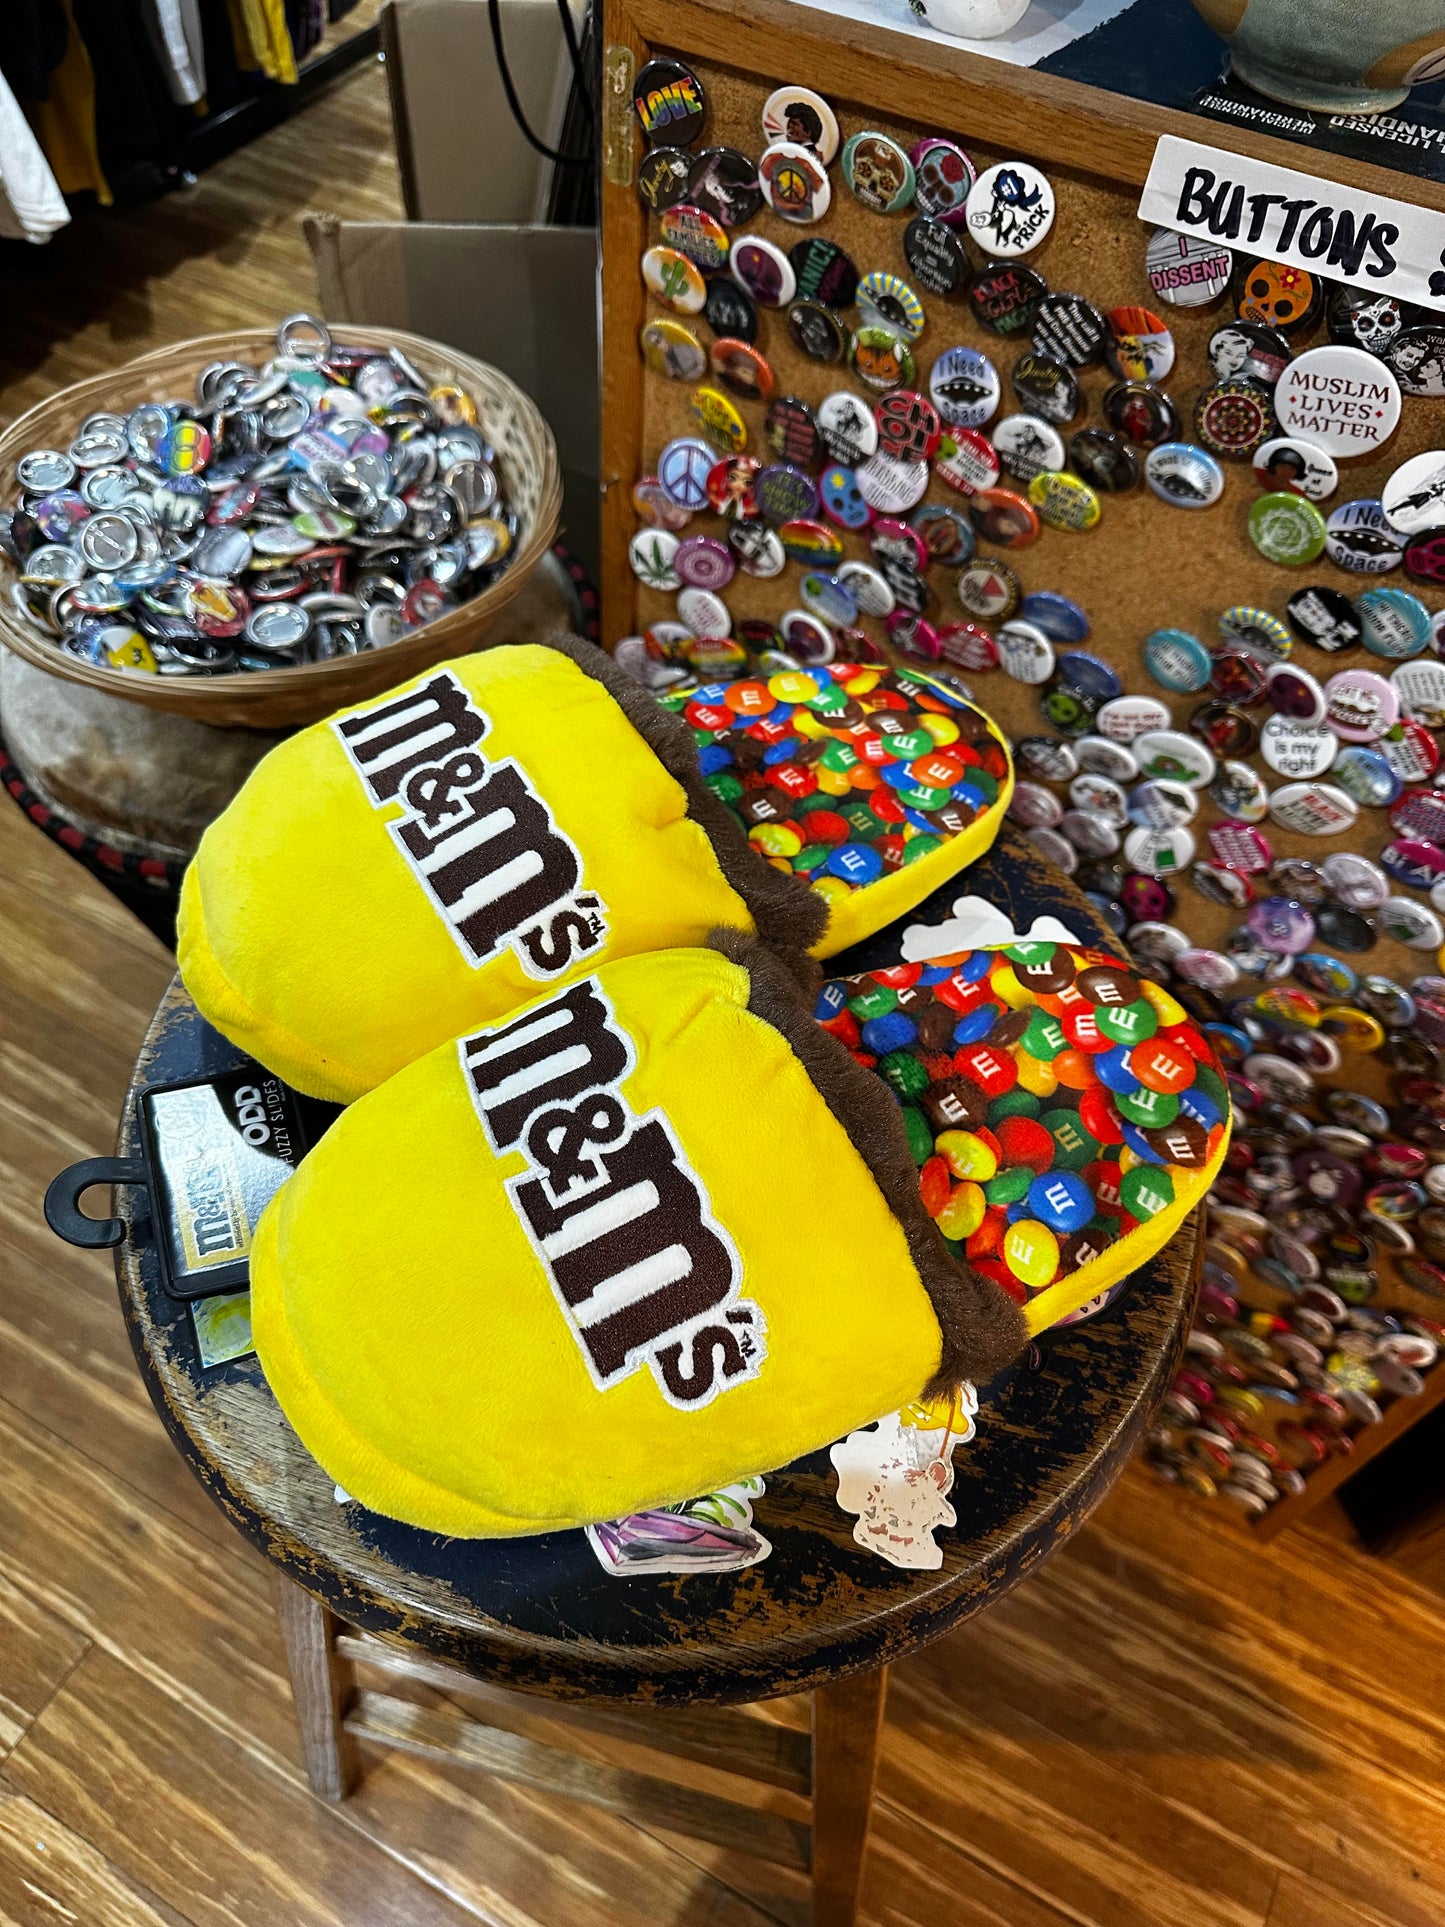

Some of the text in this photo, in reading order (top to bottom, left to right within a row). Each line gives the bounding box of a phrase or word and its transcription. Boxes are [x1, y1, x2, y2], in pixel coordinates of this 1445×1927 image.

[635, 76, 703, 131] LOVE
[1205, 95, 1317, 131] MERCHANDISE
[1329, 115, 1432, 149] LICENSED
[1002, 177, 1019, 196] #1
[1177, 167, 1400, 278] BUTTONS
[1179, 237, 1188, 256] I
[797, 240, 837, 298] ANIC!
[1150, 256, 1230, 291] DISSENT
[1039, 303, 1053, 323] Mad
[1050, 321, 1064, 339] Cow
[1068, 302, 1084, 324] They
[1081, 322, 1095, 338] call
[939, 357, 985, 378] I Need
[1289, 371, 1390, 403] MUSLIM
[941, 402, 987, 424] Space
[1301, 395, 1373, 420] LIVES
[1287, 411, 1380, 442] MATTER
[1343, 509, 1350, 525] I
[1355, 510, 1399, 536] Nee
[1334, 546, 1388, 571] Space
[1266, 720, 1330, 738] Choice
[1275, 741, 1320, 756] is my
[1278, 757, 1318, 774] right
[235, 1084, 271, 1146] ODD
[263, 1079, 295, 1164] FUZZY SLIDES
